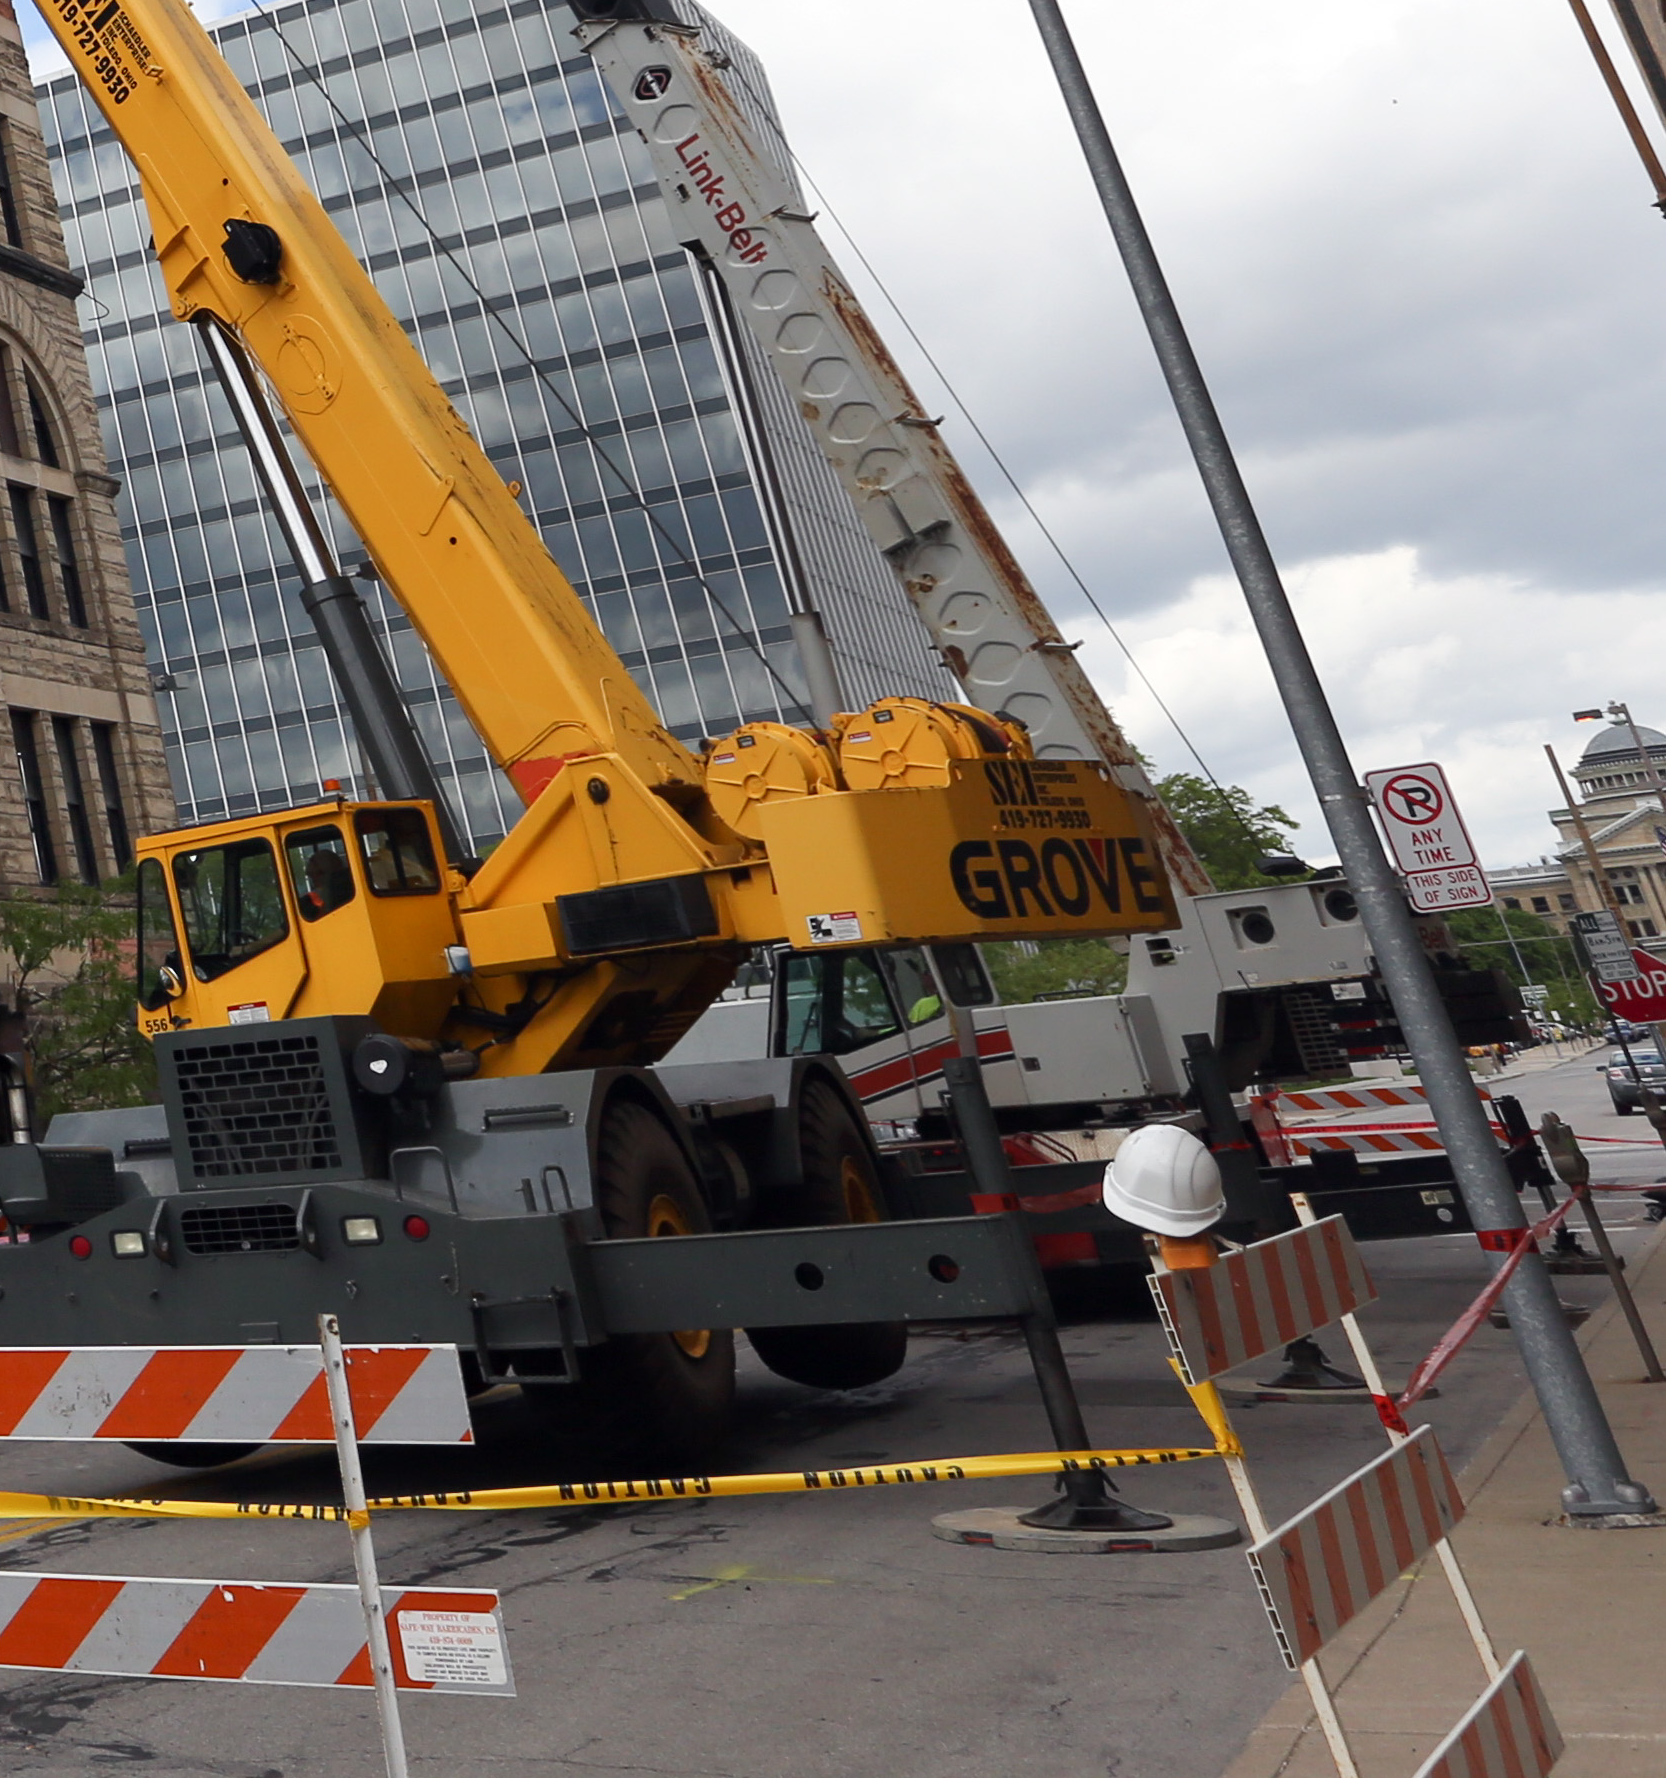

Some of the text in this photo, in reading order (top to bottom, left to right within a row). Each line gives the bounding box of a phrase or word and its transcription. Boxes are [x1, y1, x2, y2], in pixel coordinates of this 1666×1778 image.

[112, 19, 148, 70] ENTERPRISE
[675, 133, 768, 264] Link-Belt
[1411, 828, 1443, 846] ANY
[1414, 846, 1456, 865] TIME
[949, 837, 1166, 919] GROVE
[1412, 869, 1477, 888] THIS SIDE
[1424, 886, 1479, 903] OF SIGN
[145, 1018, 168, 1033] 556
[803, 1465, 966, 1488] CAUTION
[559, 1477, 711, 1501] CAUTION
